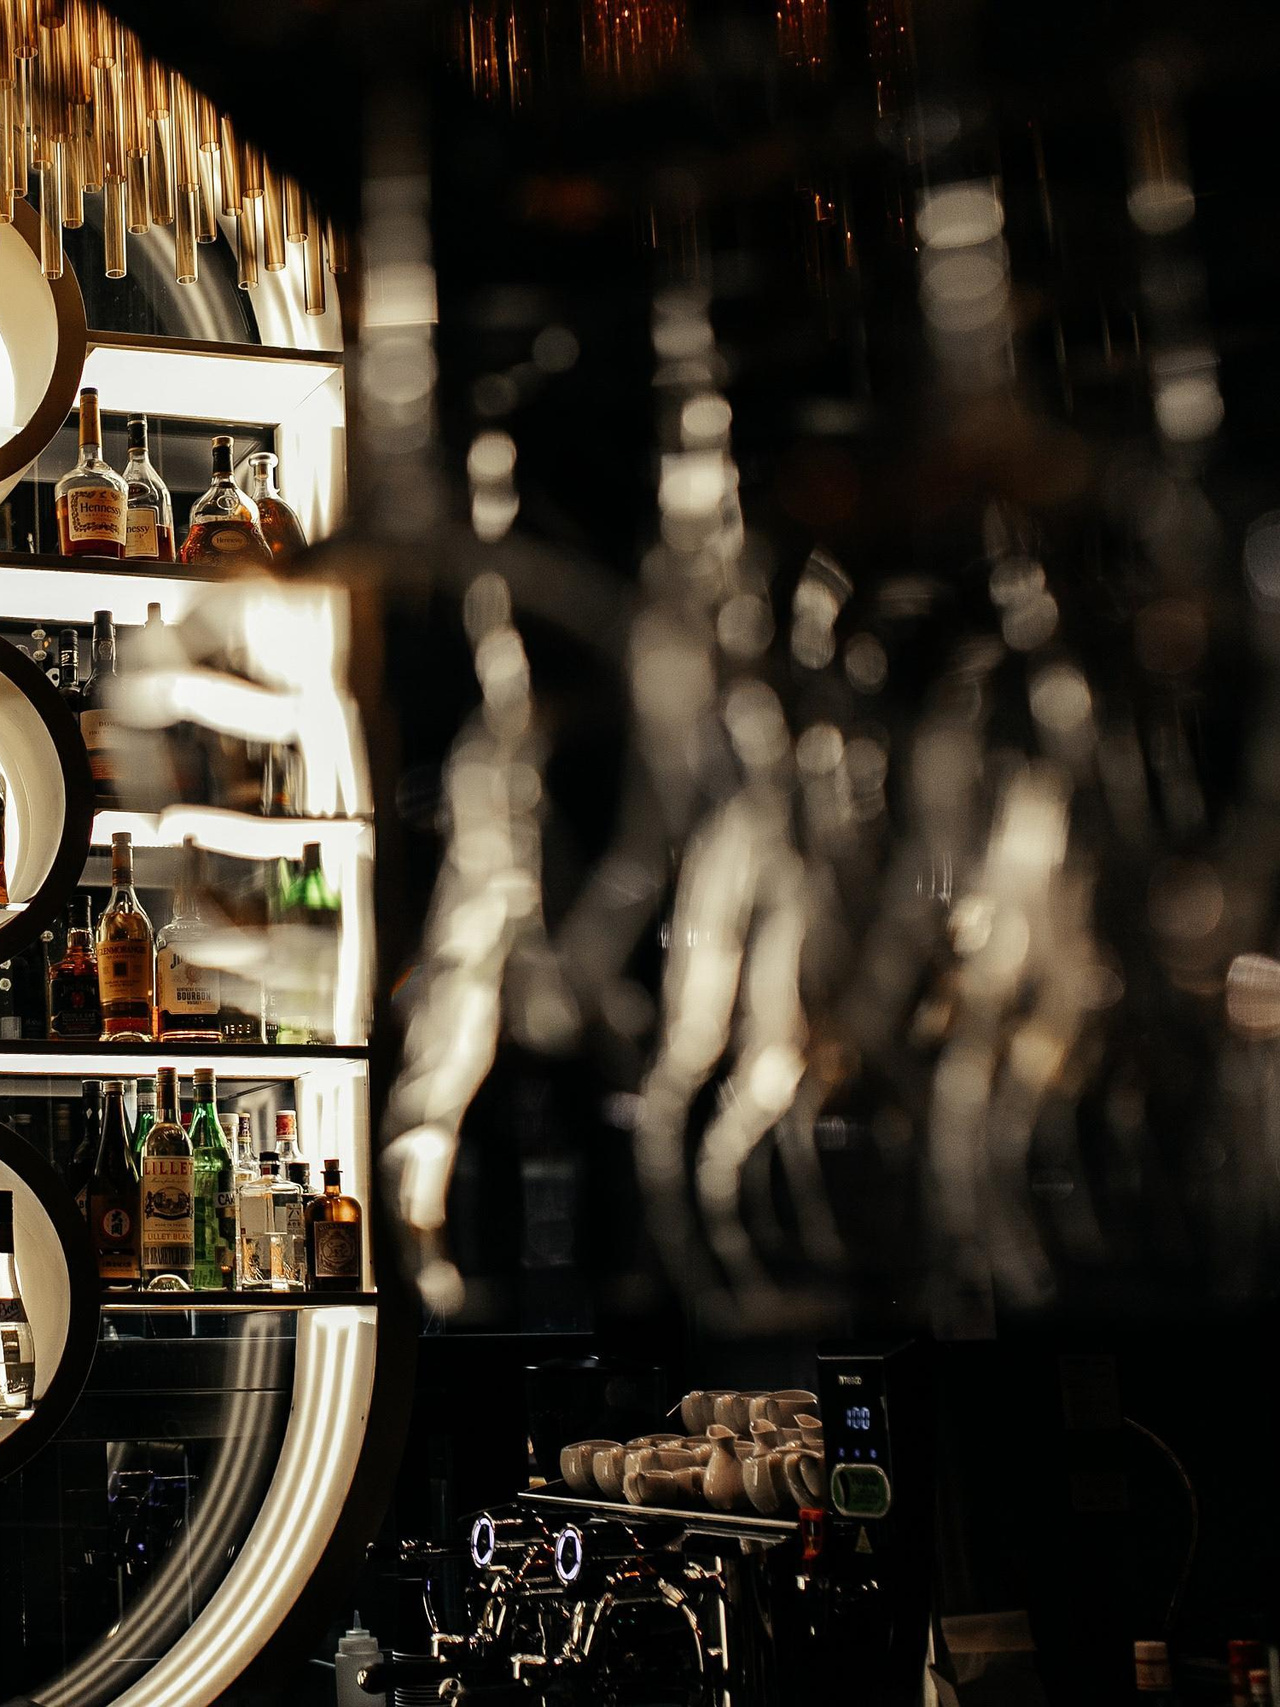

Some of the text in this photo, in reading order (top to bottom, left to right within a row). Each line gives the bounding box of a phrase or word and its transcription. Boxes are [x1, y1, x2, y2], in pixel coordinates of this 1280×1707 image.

[80, 502, 121, 517] Hennessy
[126, 525, 150, 535] nessy
[176, 991, 211, 1001] BOURBON
[144, 1161, 194, 1175] LILLET
